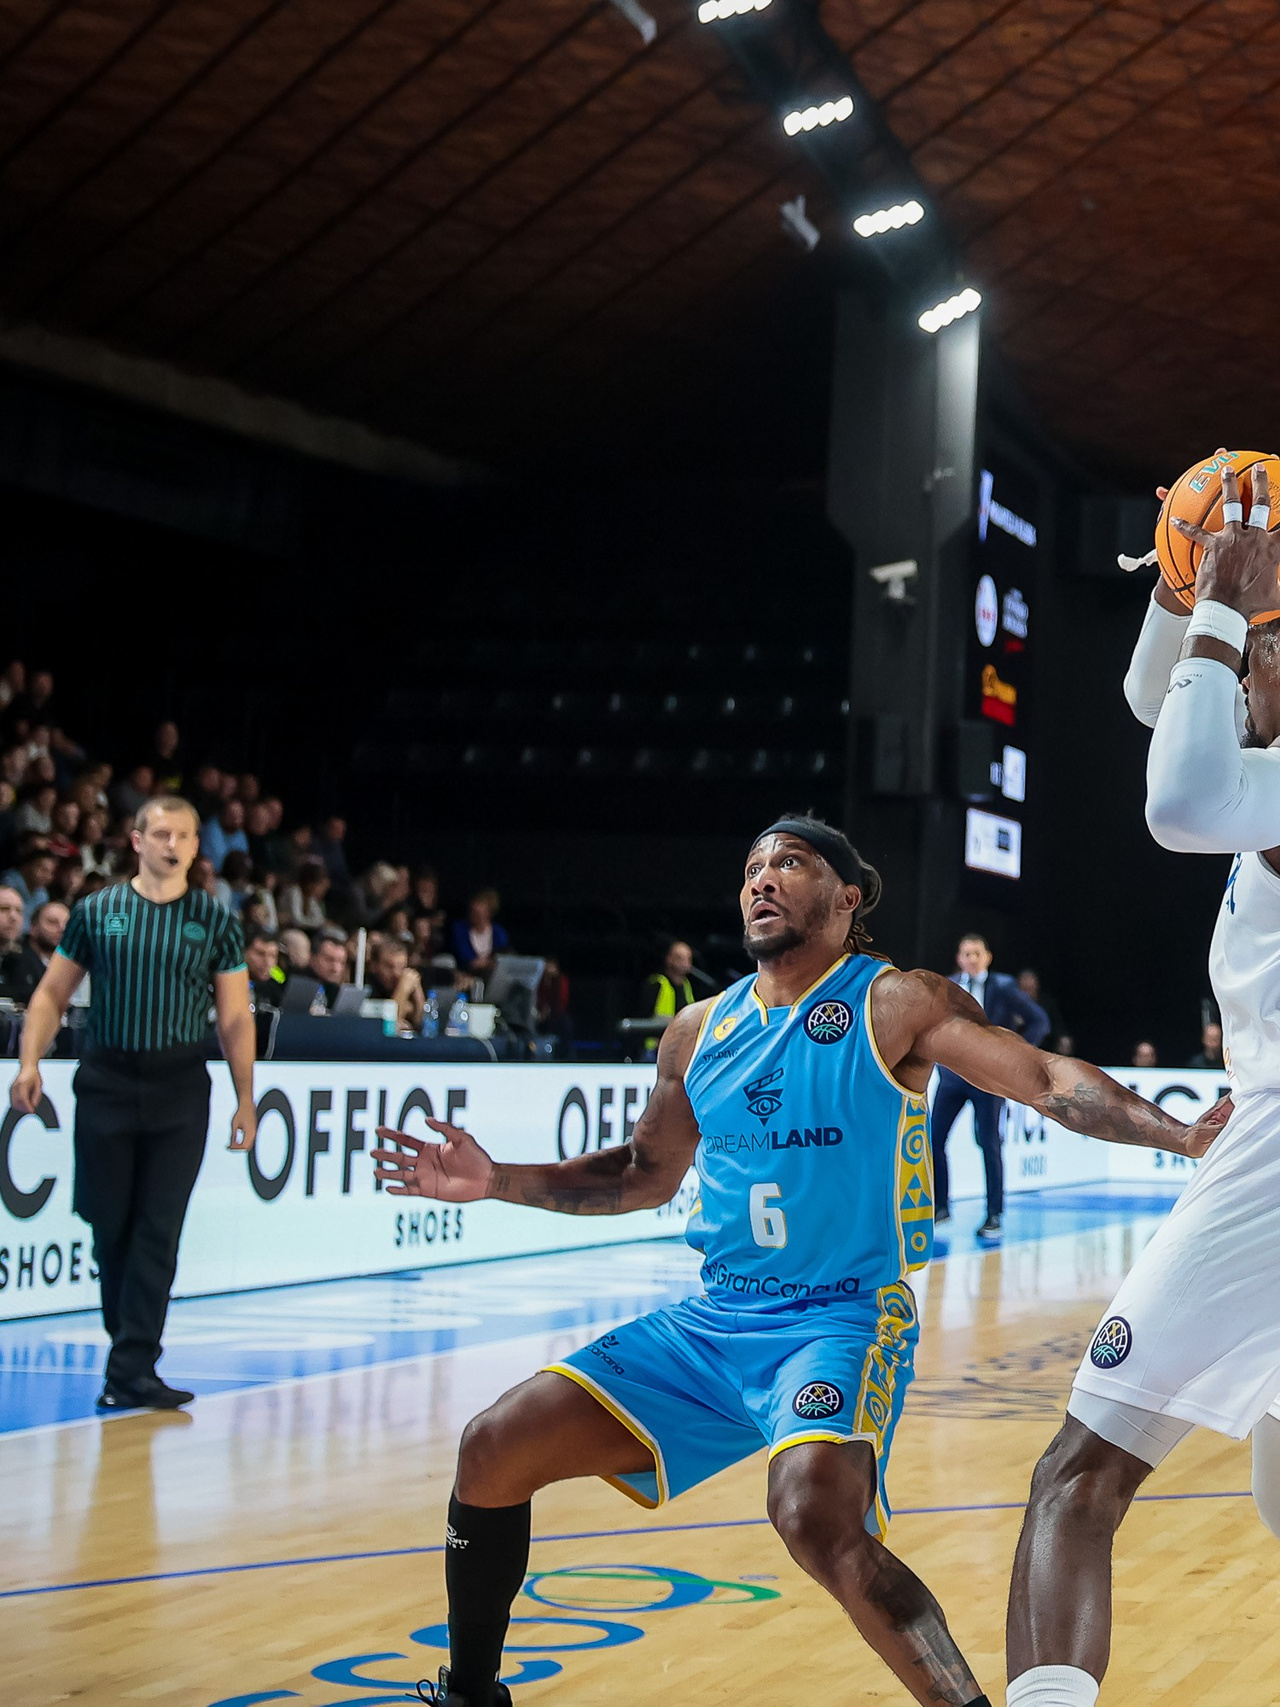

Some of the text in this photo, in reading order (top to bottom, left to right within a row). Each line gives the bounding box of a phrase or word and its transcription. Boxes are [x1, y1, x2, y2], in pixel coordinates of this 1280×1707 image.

[558, 1086, 651, 1162] OFF
[706, 1126, 844, 1155] DREAMLAND
[395, 1208, 463, 1247] SHOES
[750, 1182, 788, 1249] 6
[0, 1242, 99, 1291] SHOE
